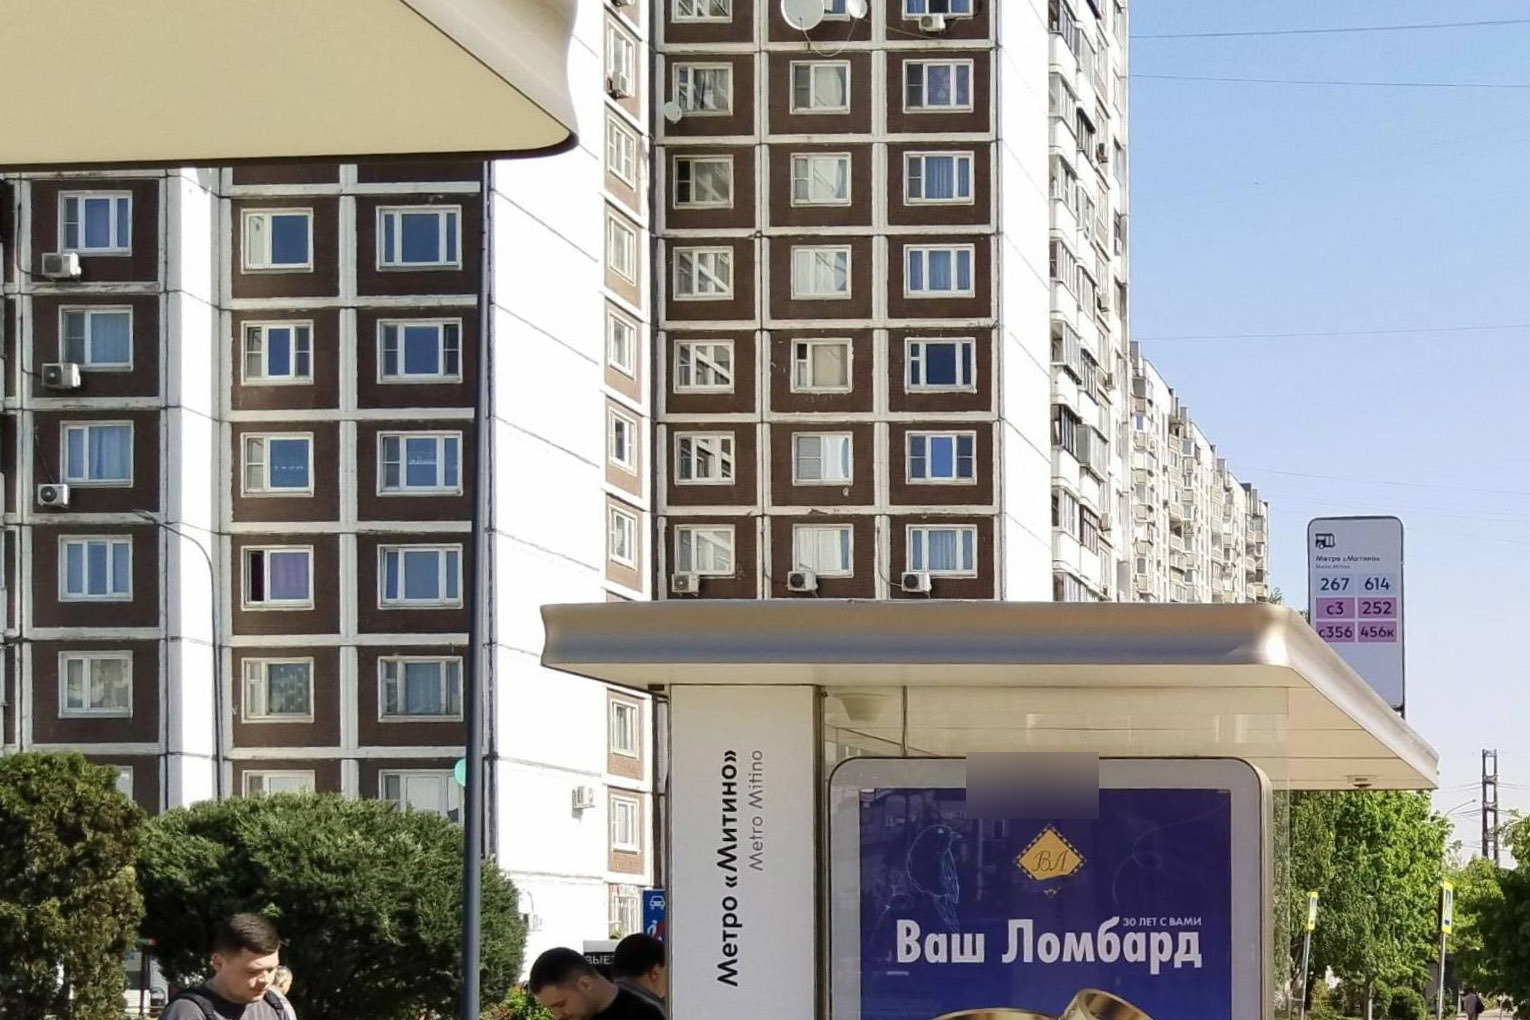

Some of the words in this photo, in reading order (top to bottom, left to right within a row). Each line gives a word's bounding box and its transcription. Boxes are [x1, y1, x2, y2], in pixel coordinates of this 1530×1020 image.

[1320, 577, 1350, 591] 267
[1364, 577, 1391, 591] 614
[1326, 601, 1344, 615] с3
[1362, 601, 1392, 615] 252
[749, 750, 763, 809] Mitino
[717, 750, 738, 888] «Митино»
[749, 816, 763, 871] Metro
[717, 896, 743, 987] Метро
[896, 919, 985, 963] Ваш
[1001, 916, 1202, 975] Ломбард
[1122, 917, 1137, 927] 30
[1139, 917, 1157, 927] ЛЕТ
[1160, 917, 1167, 927] С
[1169, 917, 1202, 927] ВАМИ
